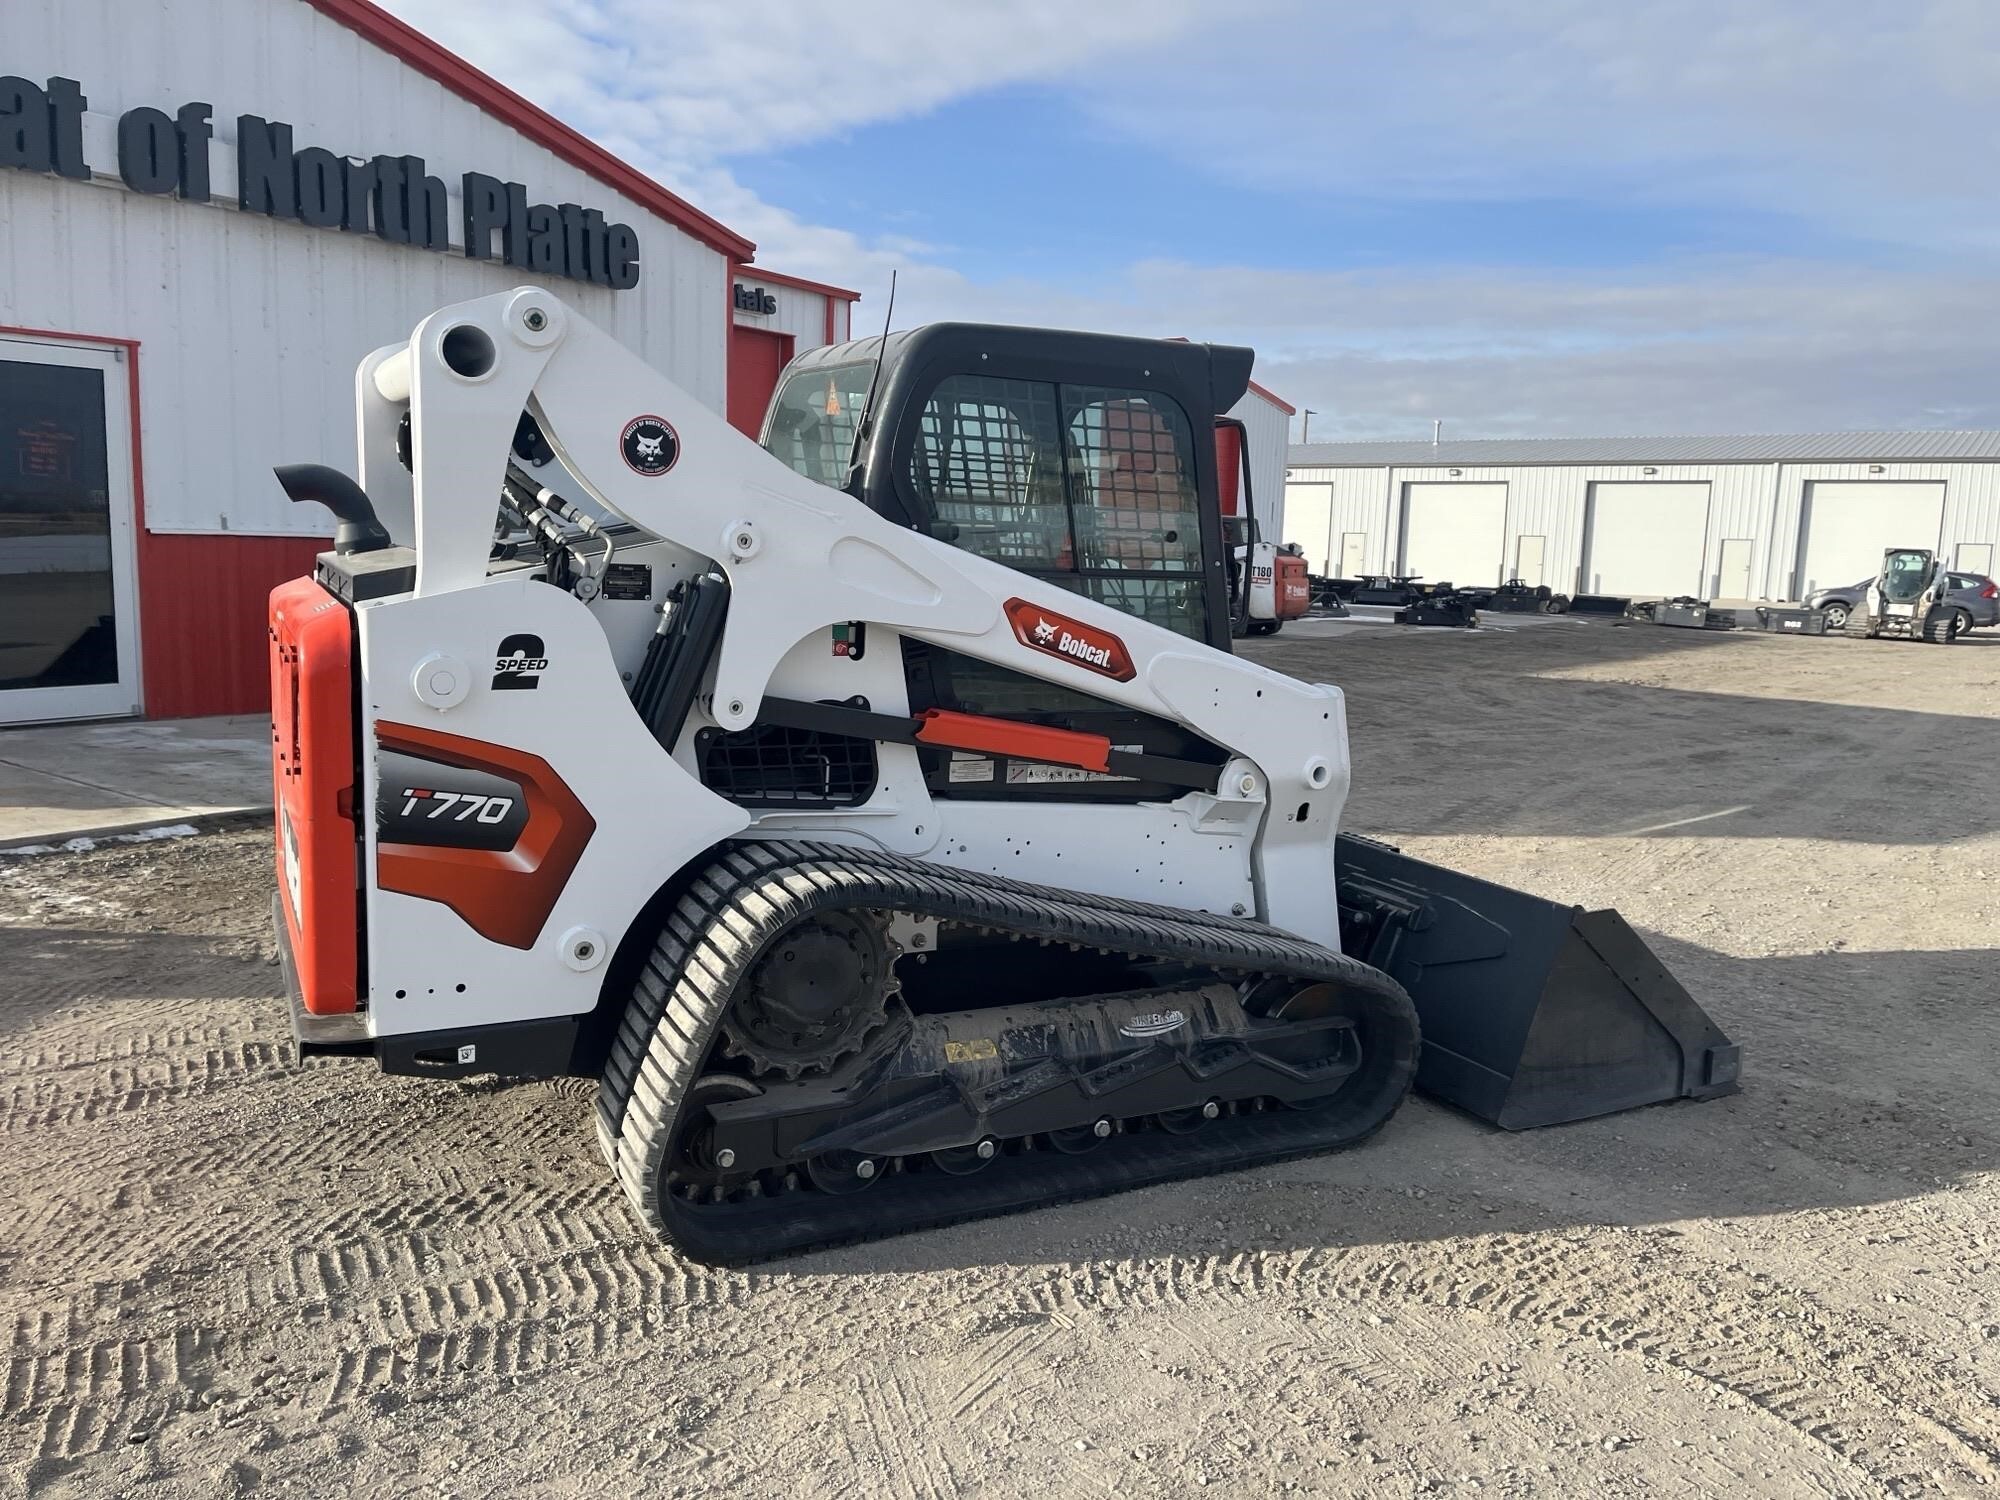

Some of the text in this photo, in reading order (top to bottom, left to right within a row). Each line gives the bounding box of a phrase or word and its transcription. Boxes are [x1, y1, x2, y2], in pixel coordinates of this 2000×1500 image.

[118, 102, 213, 202] of
[237, 114, 449, 251] North
[462, 171, 640, 290] Platte
[491, 633, 545, 691] 2
[494, 659, 549, 671] SPEED
[1058, 631, 1111, 668] Bobcat
[400, 788, 514, 824] T770
